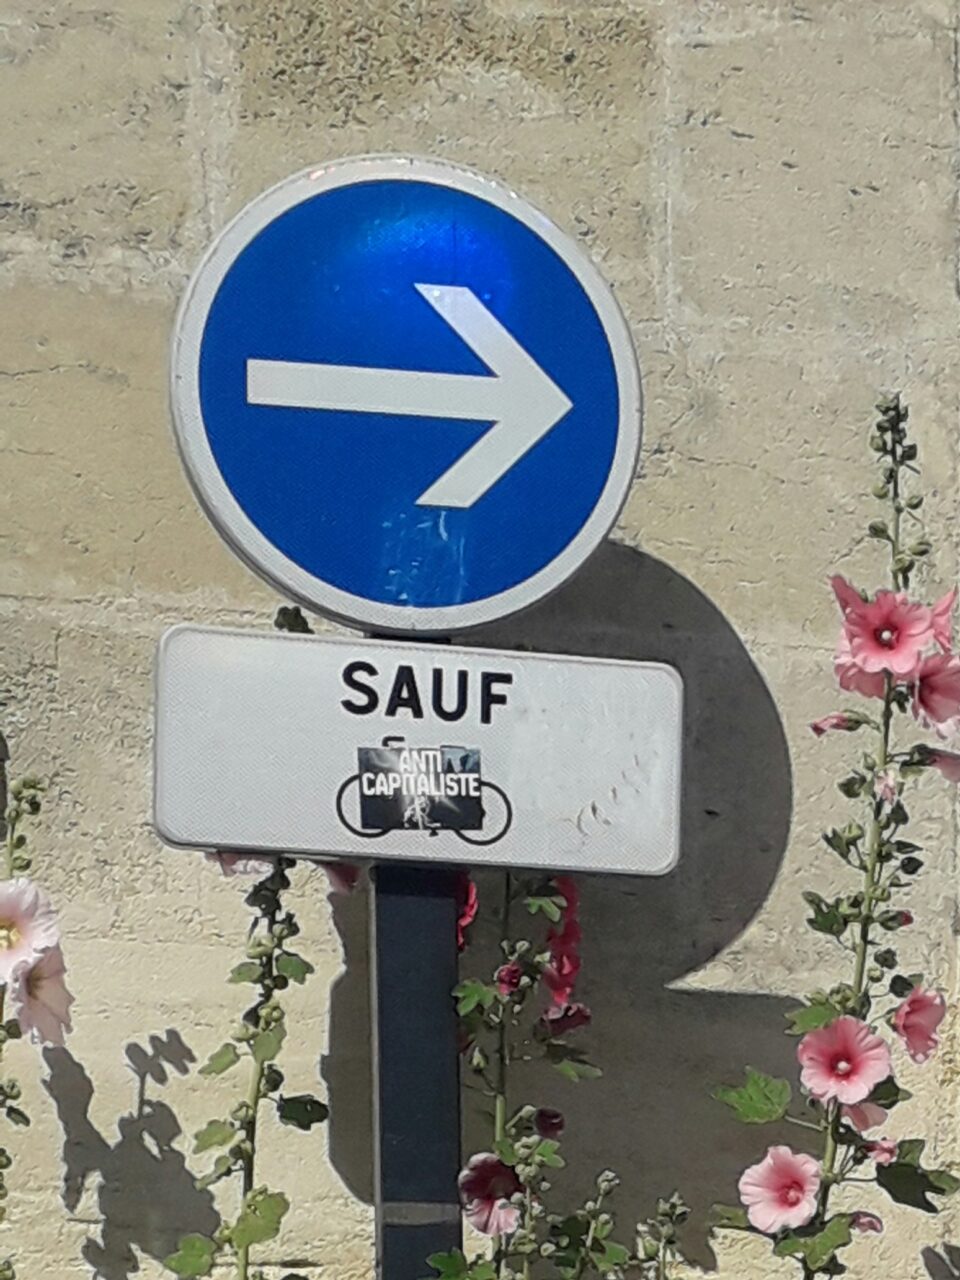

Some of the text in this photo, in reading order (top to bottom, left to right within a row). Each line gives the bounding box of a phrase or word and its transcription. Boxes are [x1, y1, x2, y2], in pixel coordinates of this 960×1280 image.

[340, 661, 513, 724] SAUF
[400, 750, 442, 773] ANTI
[361, 772, 481, 797] CAPITALISTE
